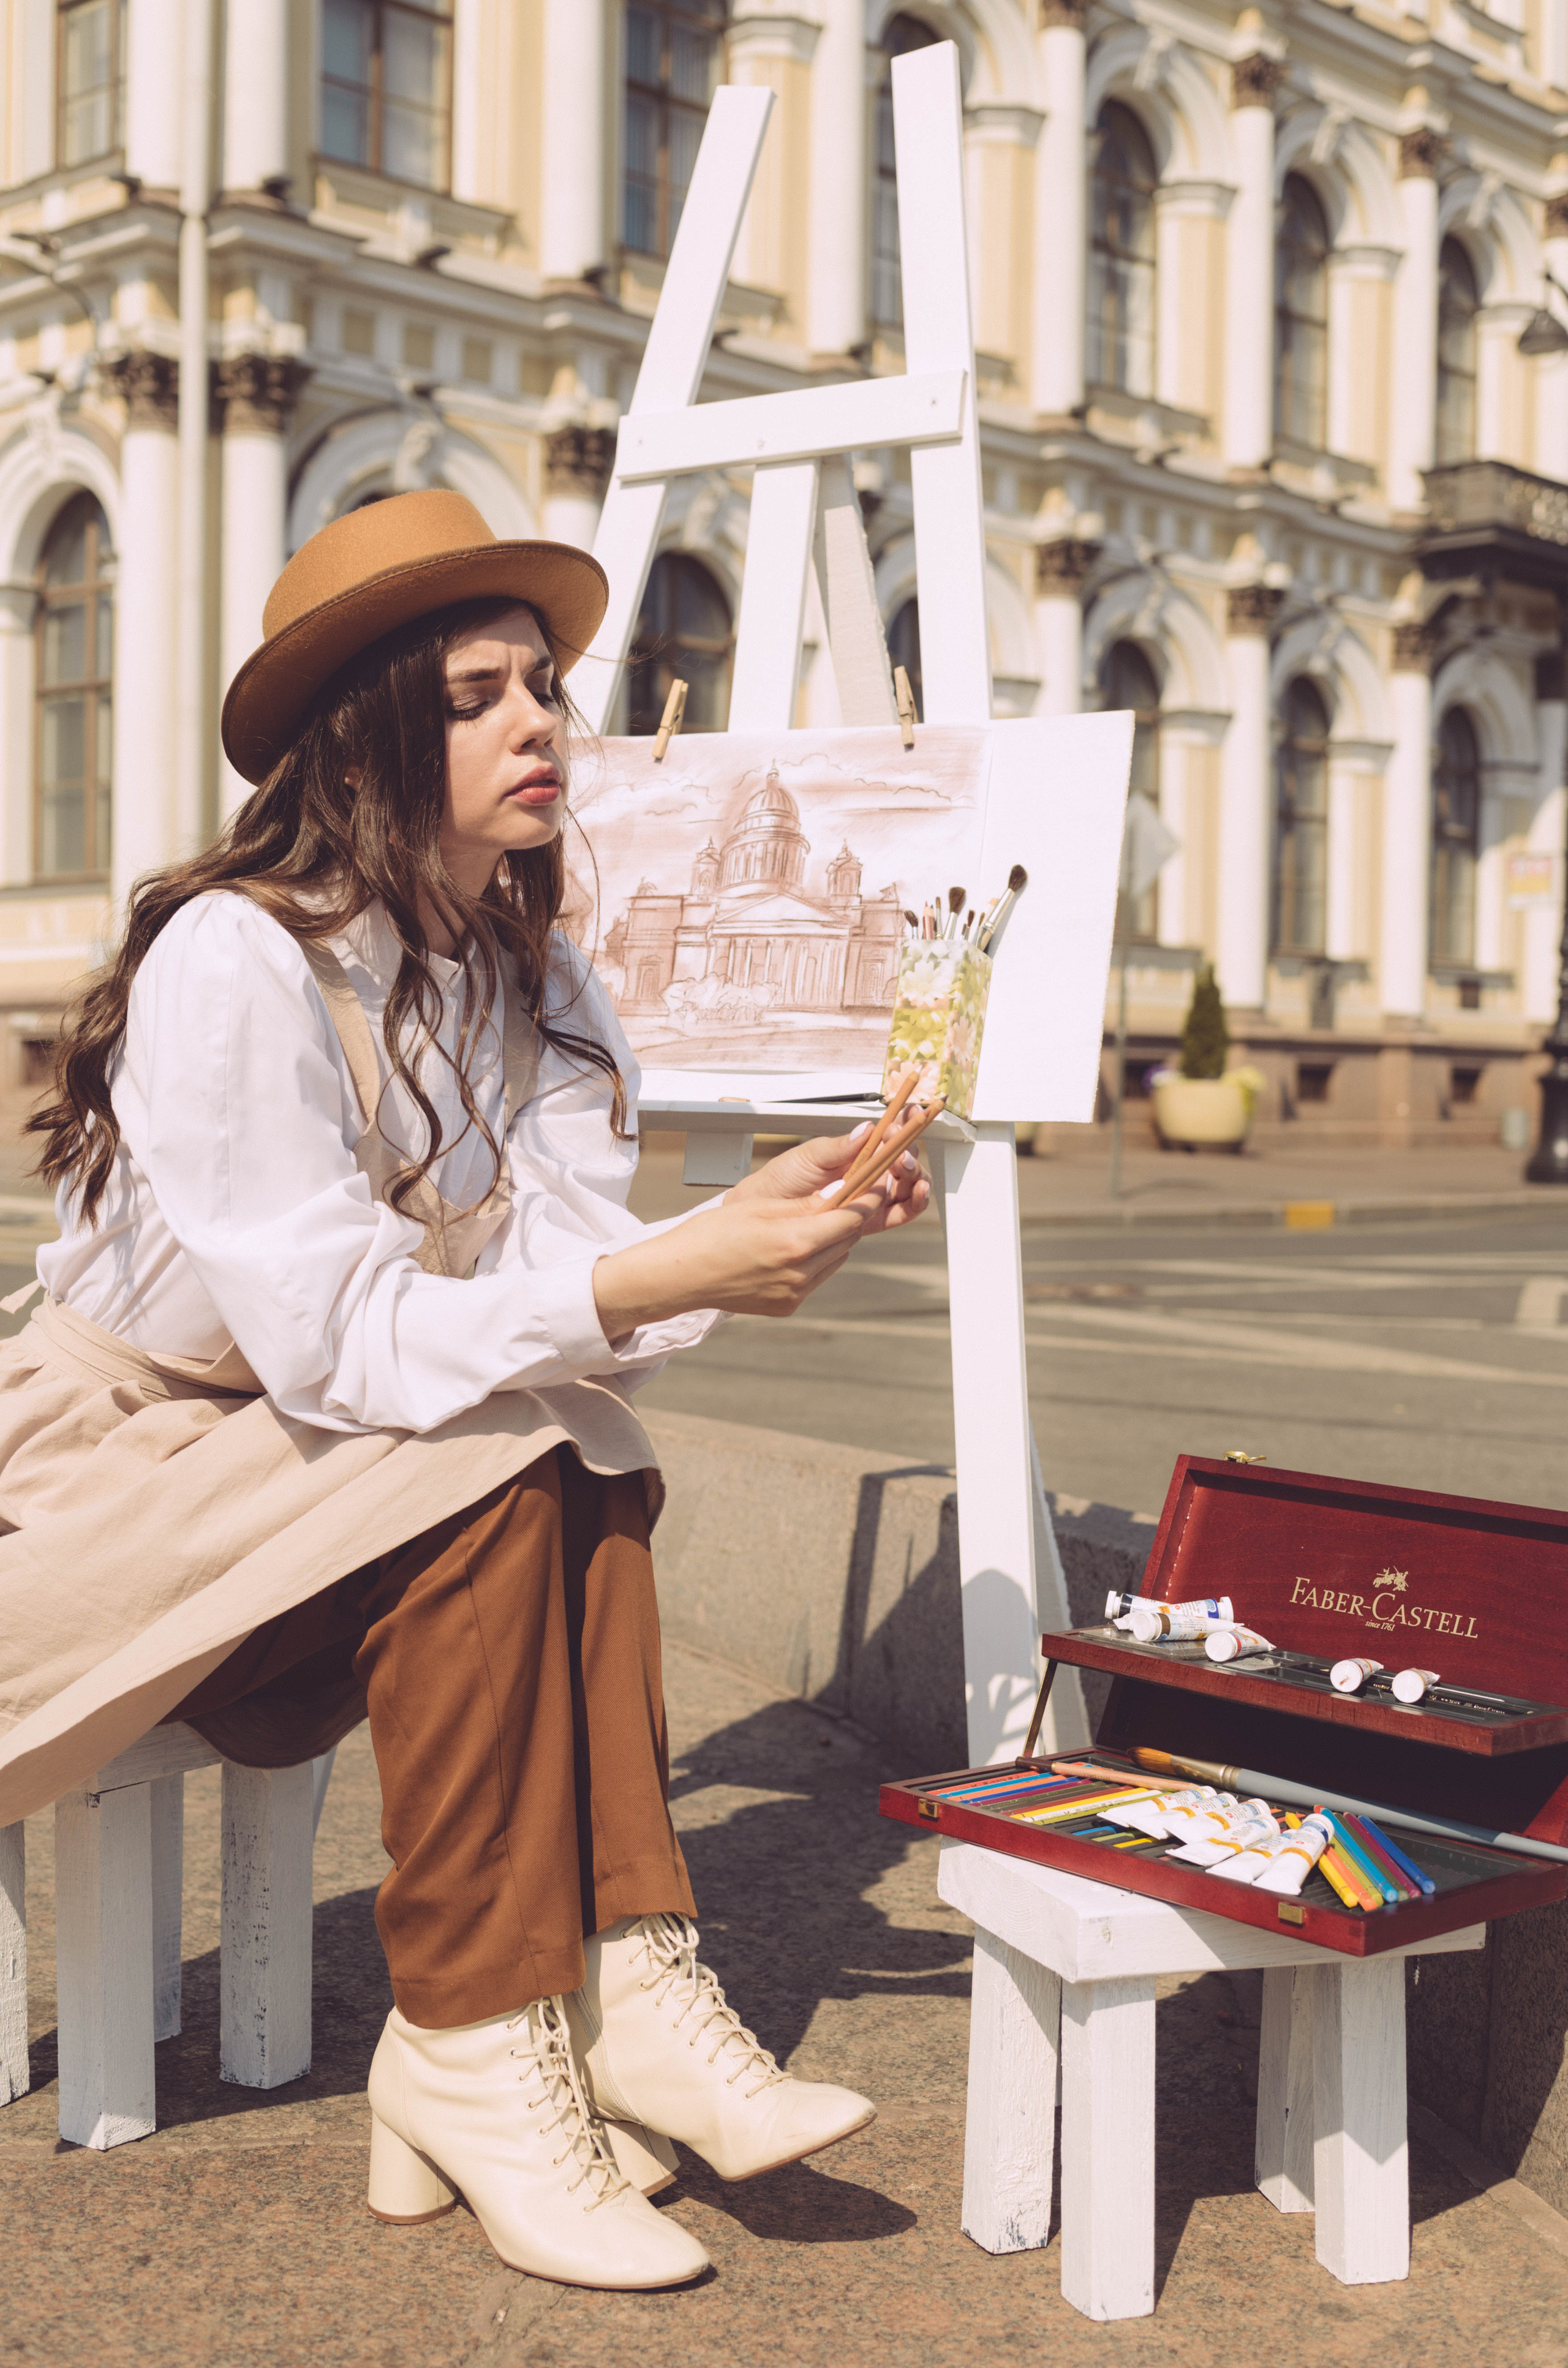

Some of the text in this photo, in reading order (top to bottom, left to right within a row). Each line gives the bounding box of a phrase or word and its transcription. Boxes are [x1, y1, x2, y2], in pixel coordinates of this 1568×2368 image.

[1289, 1576, 1479, 1638] FABER-CASTELL
[1365, 1620, 1395, 1632] since 1761
